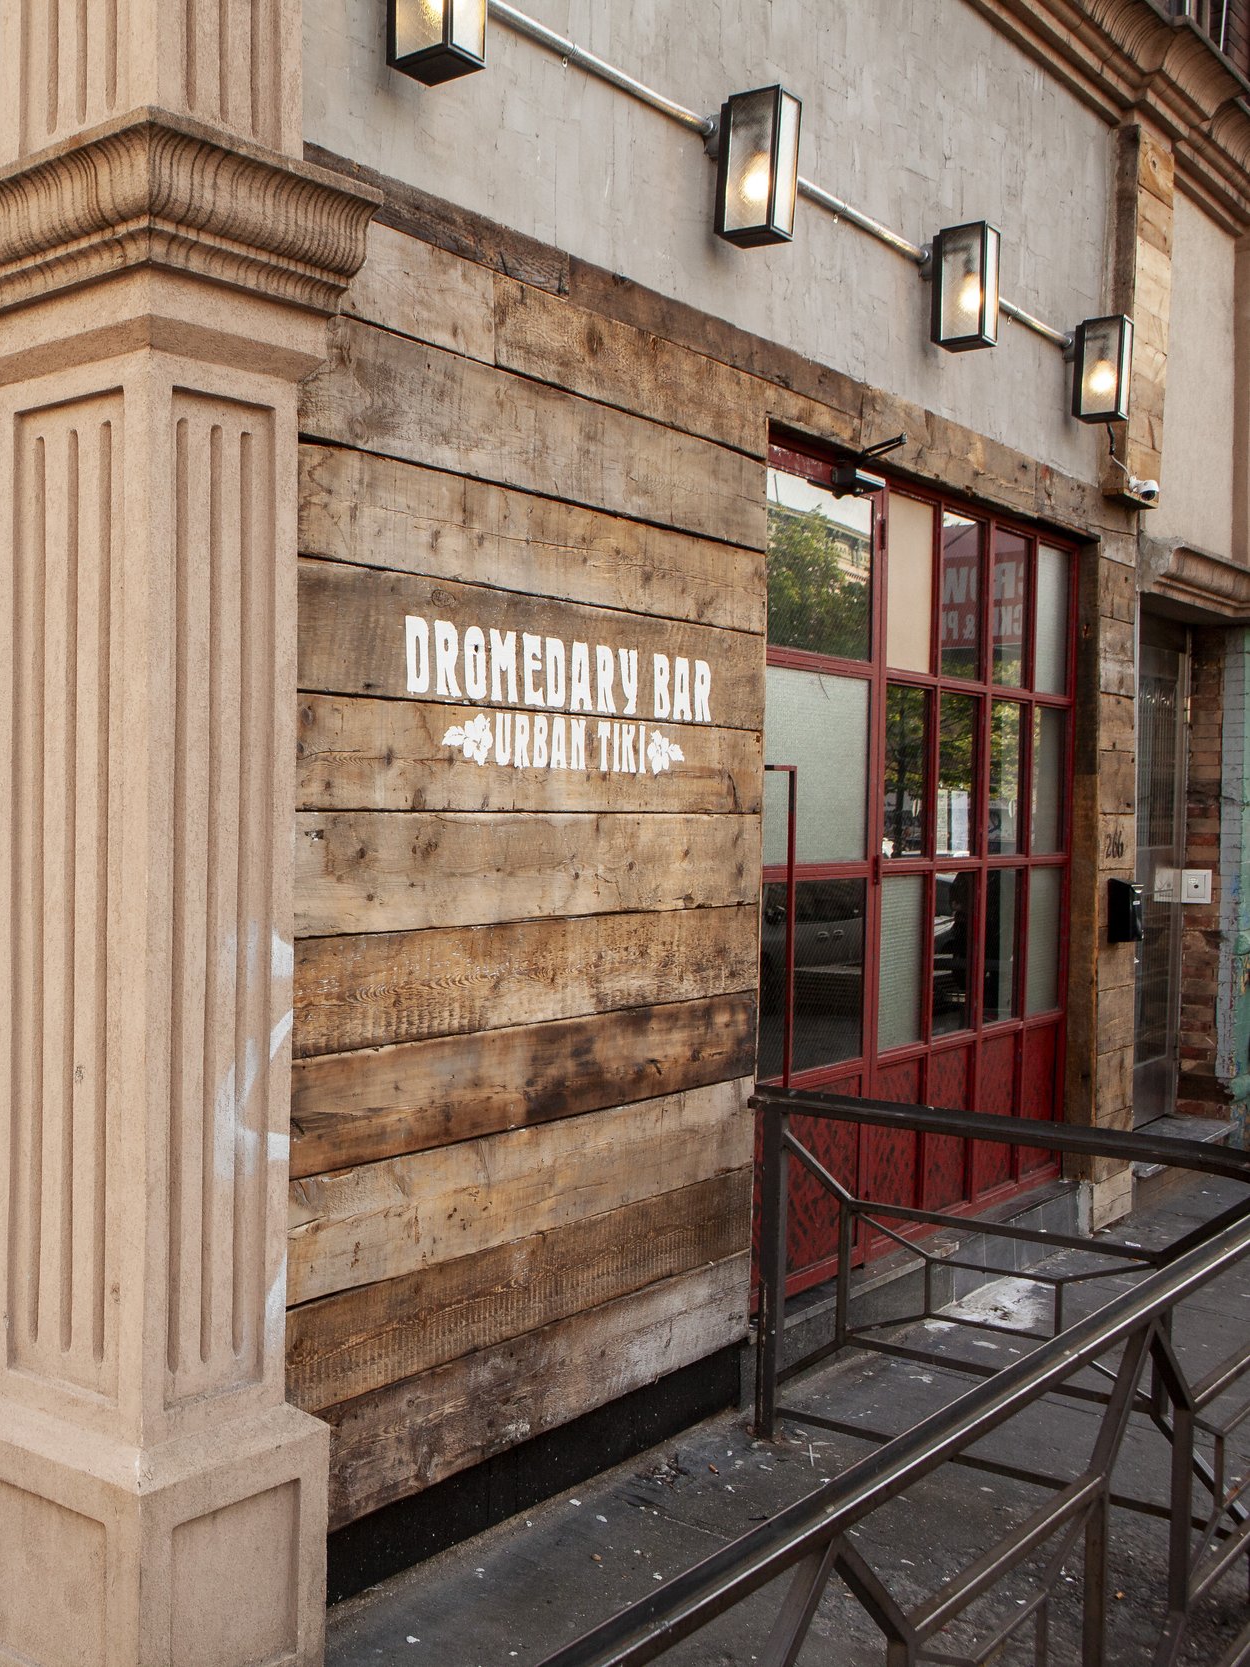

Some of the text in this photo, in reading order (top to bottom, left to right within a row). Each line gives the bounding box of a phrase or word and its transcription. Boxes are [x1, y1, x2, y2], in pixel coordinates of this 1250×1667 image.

[405, 615, 712, 722] DROMEDARY BAR
[495, 712, 647, 774] URBAN TIKI
[1105, 829, 1124, 859] 266
